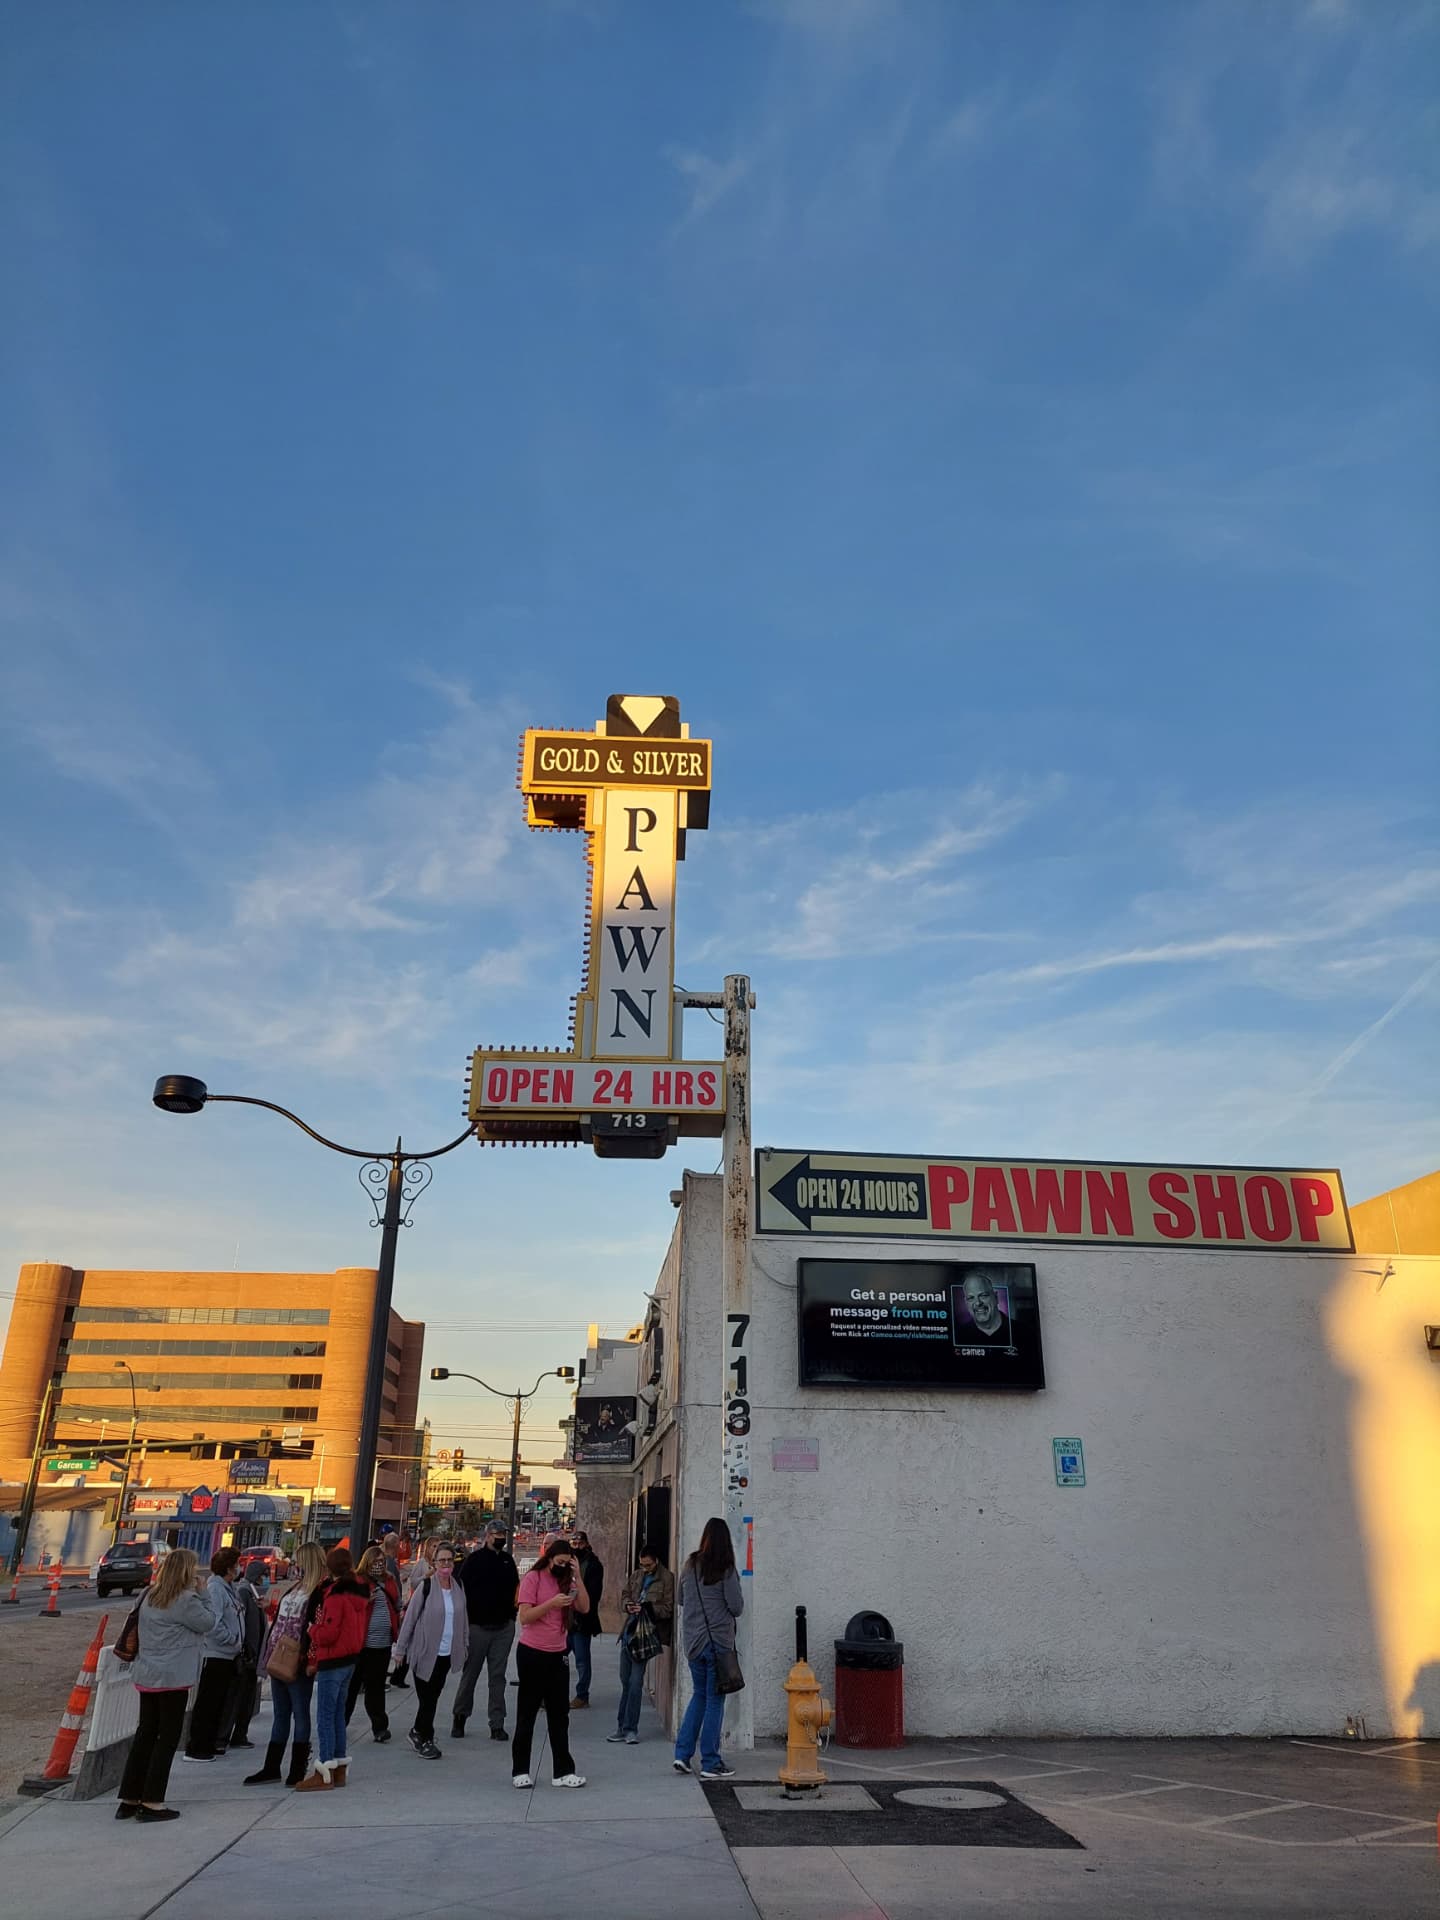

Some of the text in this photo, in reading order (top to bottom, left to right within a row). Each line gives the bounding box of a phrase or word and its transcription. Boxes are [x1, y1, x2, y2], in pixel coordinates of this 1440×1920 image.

[540, 747, 704, 777] GOLD & SILVER
[606, 807, 666, 1039] PAWN
[487, 1067, 718, 1106] OPEN 24 HRS
[611, 1113, 647, 1129] 713
[796, 1176, 919, 1213] OPEN 24 HOURS
[928, 1164, 1335, 1243] PAWN SHOP
[850, 1289, 946, 1304] Get a personal
[830, 1306, 948, 1320] message from me
[830, 1322, 857, 1331] Request
[862, 1323, 901, 1331] personalized
[920, 1325, 948, 1333] message
[831, 1330, 847, 1338] from
[961, 1347, 986, 1357] cameo
